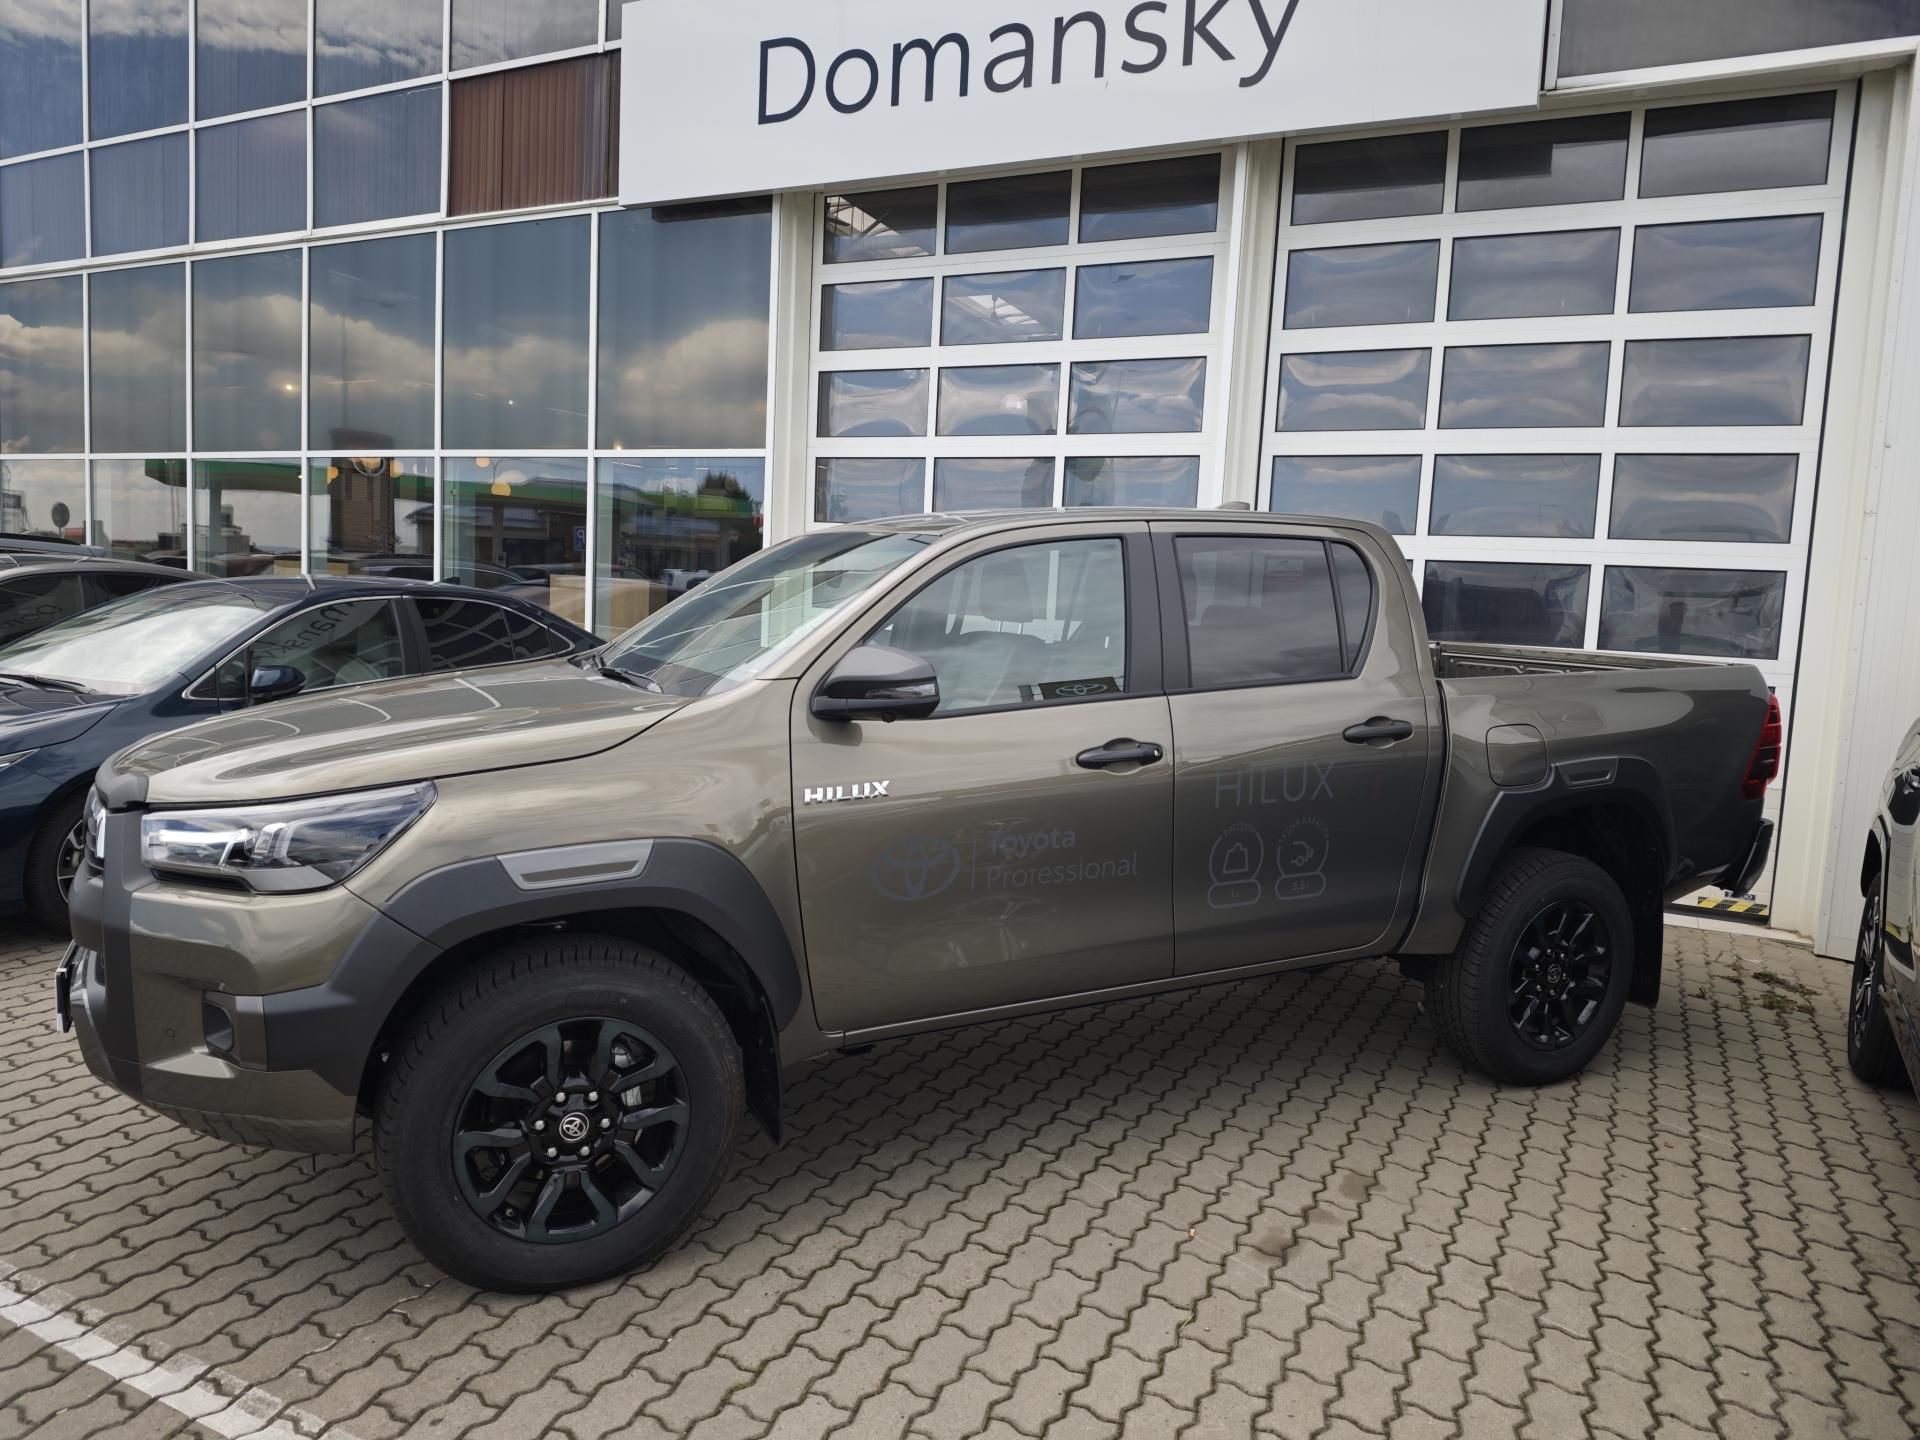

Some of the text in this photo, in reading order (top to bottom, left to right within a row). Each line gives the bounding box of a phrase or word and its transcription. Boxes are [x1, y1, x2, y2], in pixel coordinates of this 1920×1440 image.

[757, 0, 1299, 125] Domansky
[804, 780, 889, 805] HILUX
[1214, 761, 1335, 808] HILUX
[991, 828, 1076, 857] Toyota
[986, 851, 1138, 890] Professional
